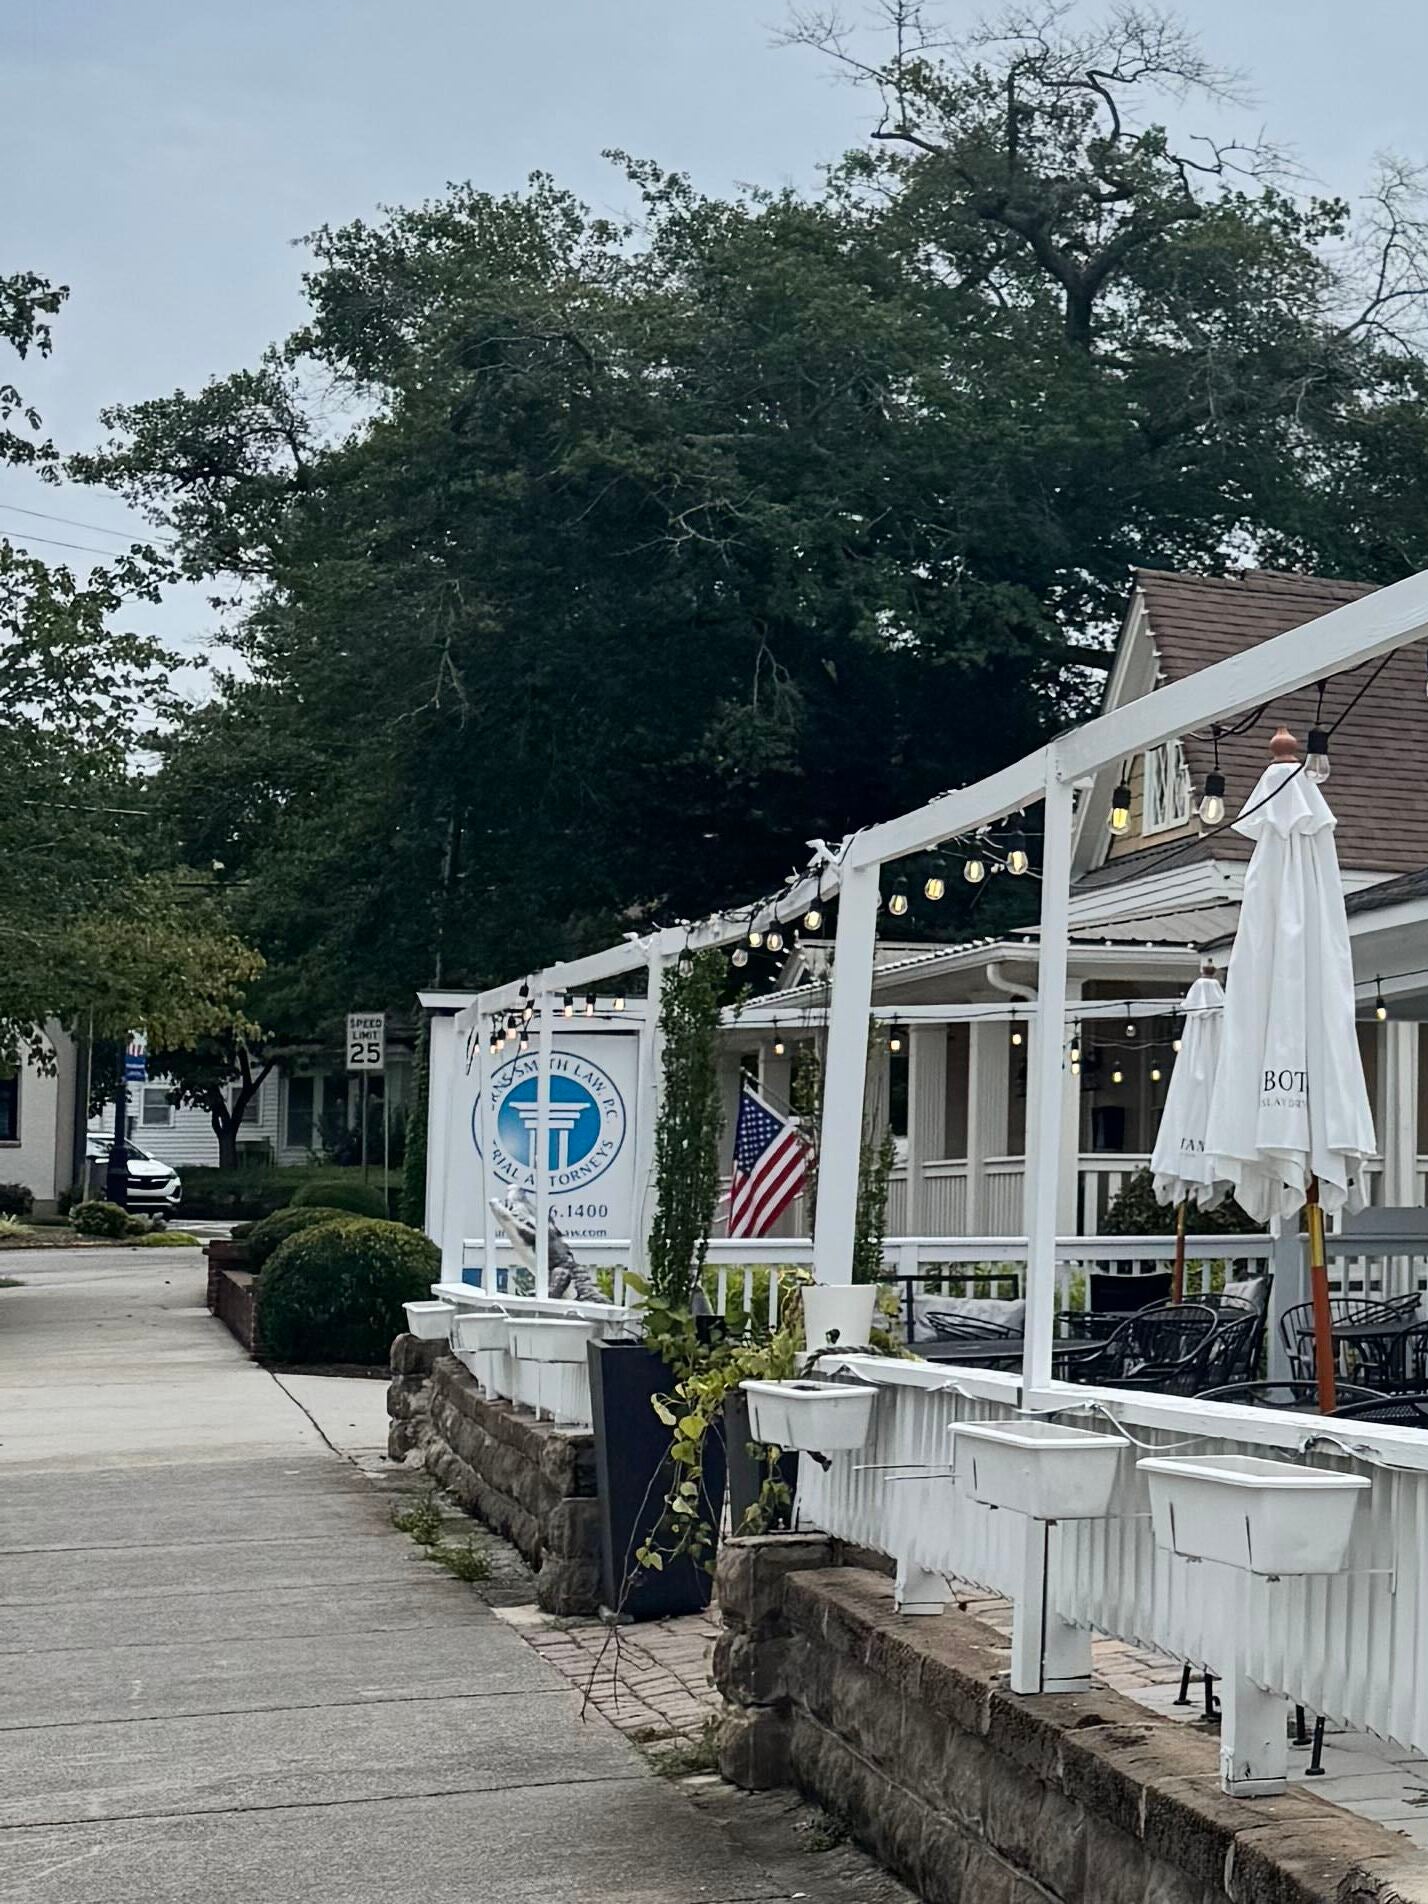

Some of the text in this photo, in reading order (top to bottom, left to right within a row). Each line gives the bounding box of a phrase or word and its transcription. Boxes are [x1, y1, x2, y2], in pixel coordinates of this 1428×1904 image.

[350, 1018, 382, 1028] SPEED
[352, 1030, 378, 1040] LIMIT
[350, 1042, 380, 1064] 25
[515, 1058, 568, 1078] SMTH
[493, 1139, 614, 1187] RIAL ATORNEYS
